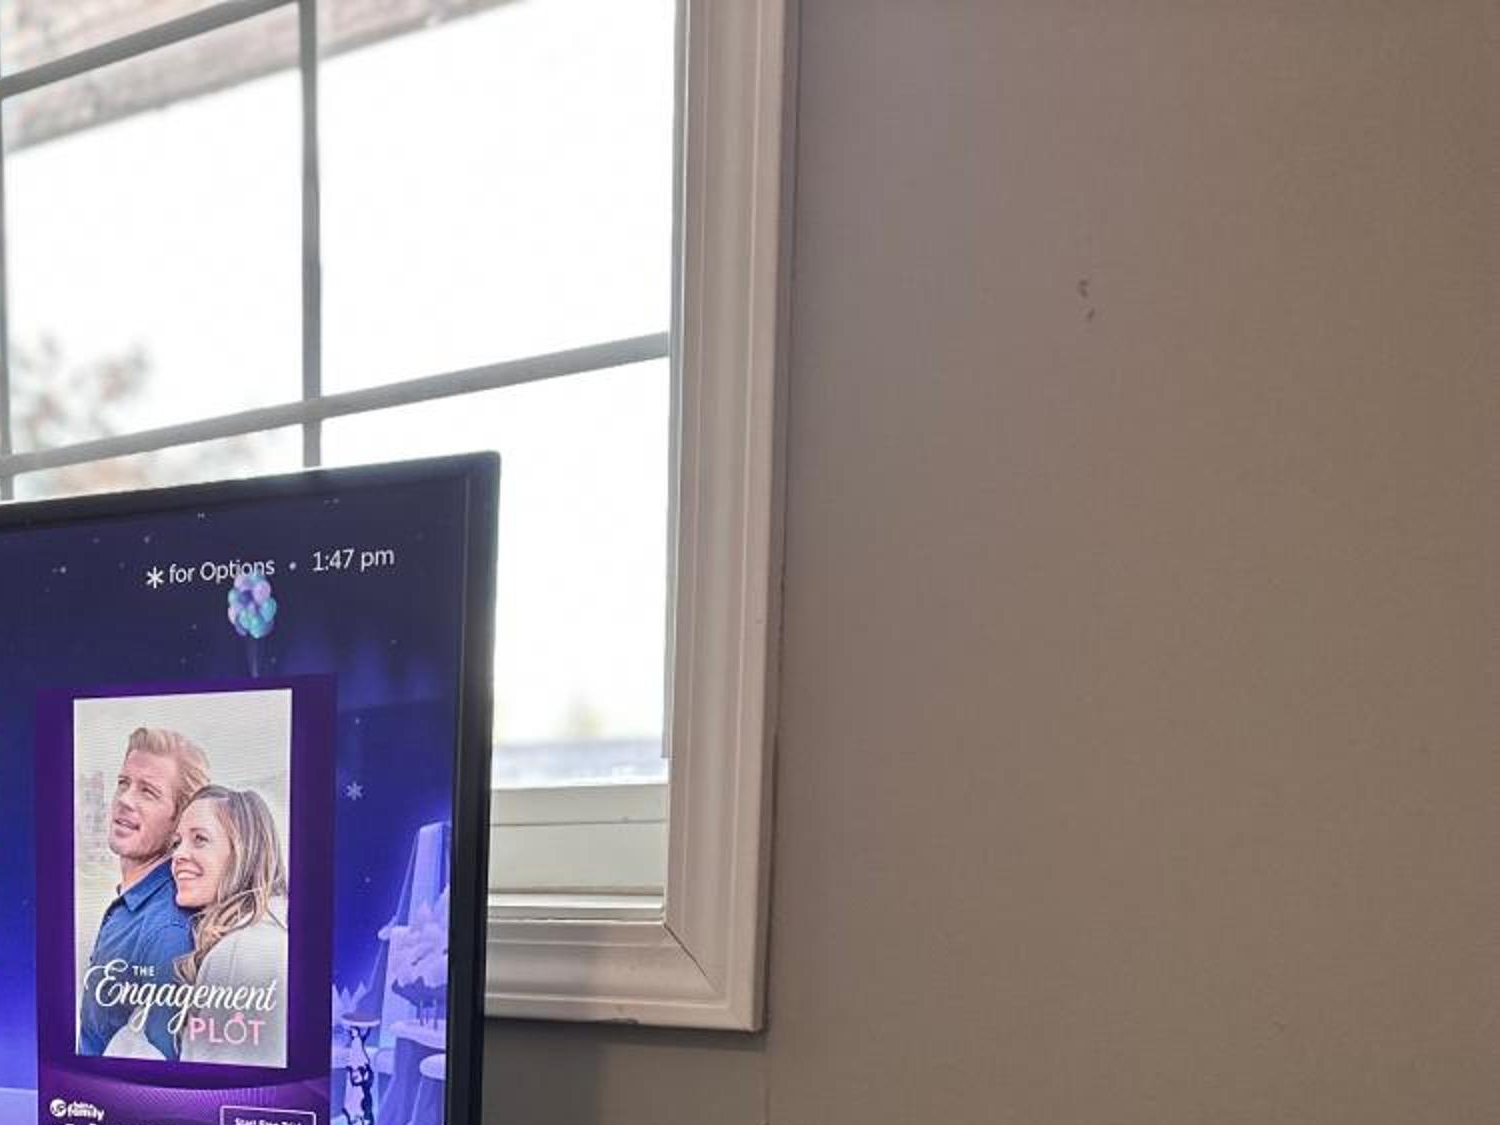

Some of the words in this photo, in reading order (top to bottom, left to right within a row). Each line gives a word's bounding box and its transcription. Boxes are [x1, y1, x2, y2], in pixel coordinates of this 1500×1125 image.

[169, 564, 195, 583] for
[200, 560, 275, 584] Options
[312, 549, 354, 571] 1:47
[360, 550, 395, 572] pm
[132, 965, 155, 977] THE
[84, 958, 277, 1035] Engagement
[188, 1014, 266, 1046] PLOT
